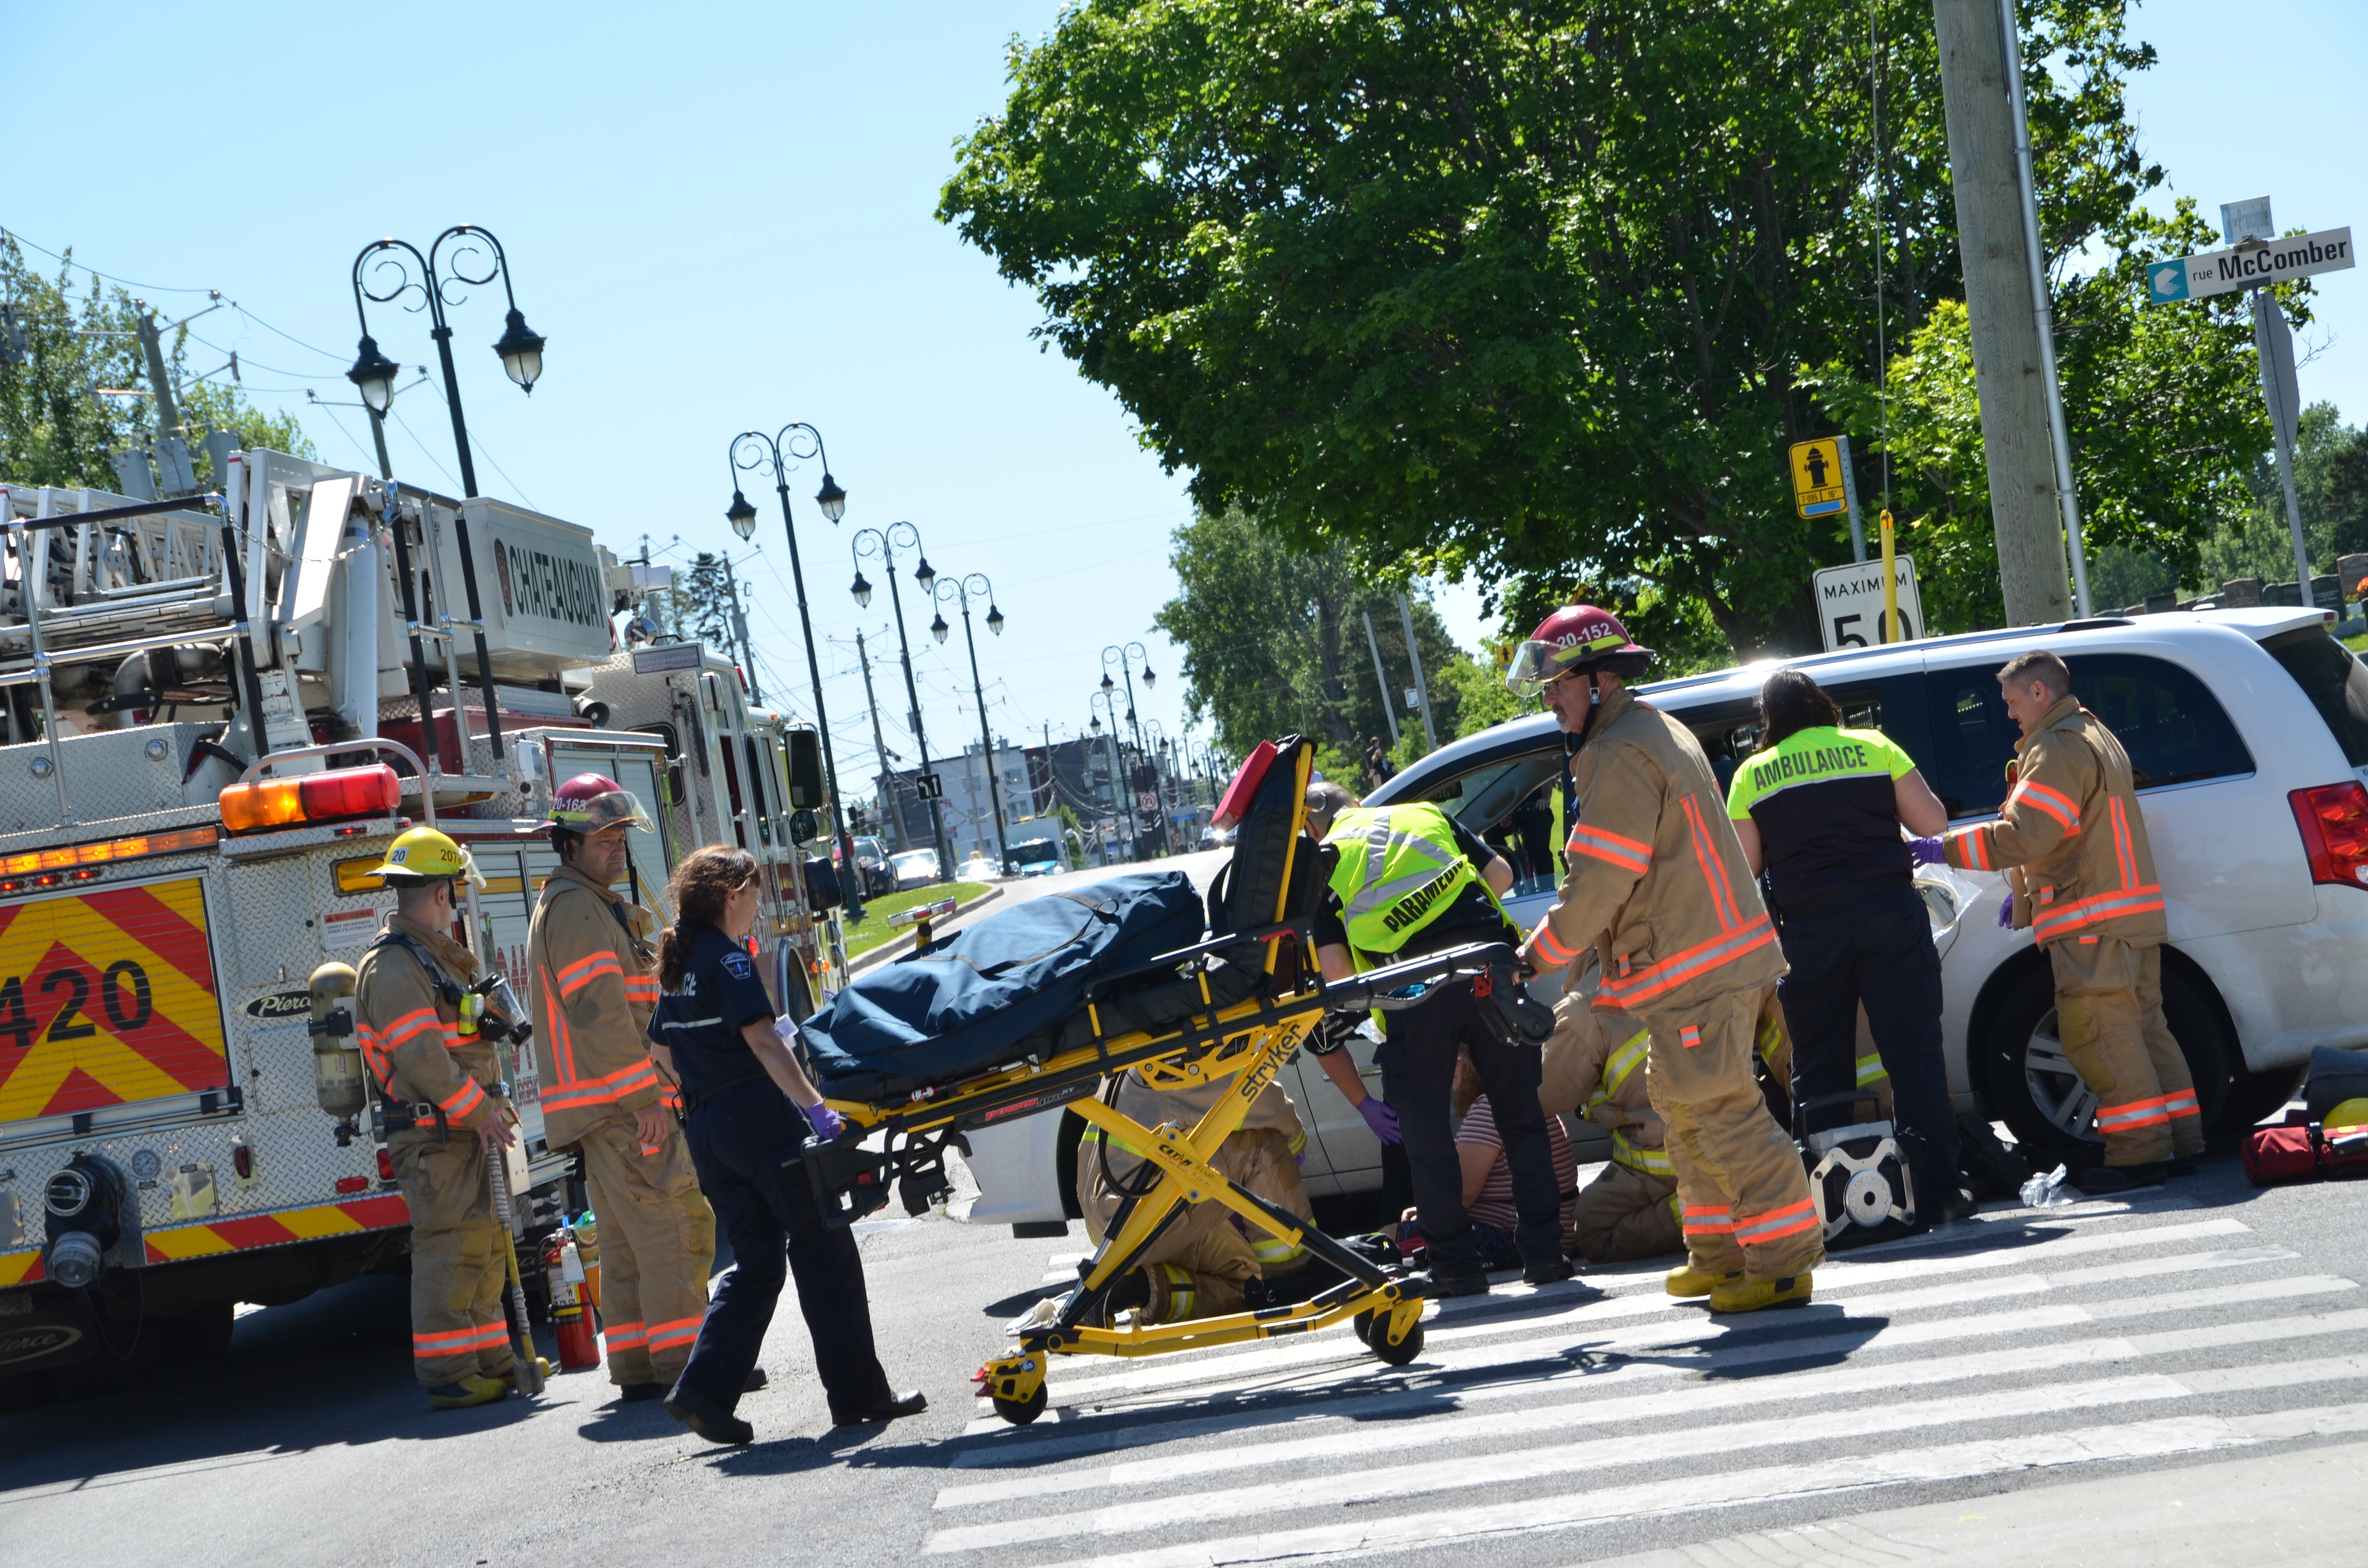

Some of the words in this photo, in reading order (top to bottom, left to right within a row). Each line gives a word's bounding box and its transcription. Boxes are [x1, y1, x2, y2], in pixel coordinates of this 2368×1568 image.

[2237, 203, 2269, 233] Principale
[2192, 270, 2213, 281] rue
[2218, 240, 2347, 281] McComber
[1801, 493, 1818, 503] 7-095
[509, 545, 604, 628] CHATEAUGUAY
[1824, 573, 1907, 600] MAXIMM
[1556, 622, 1613, 651] 20-152
[1753, 745, 1868, 792] AMBULANCE
[391, 850, 406, 861] 20
[258, 996, 311, 1017] Pierc
[1241, 1024, 1301, 1103] stryker
